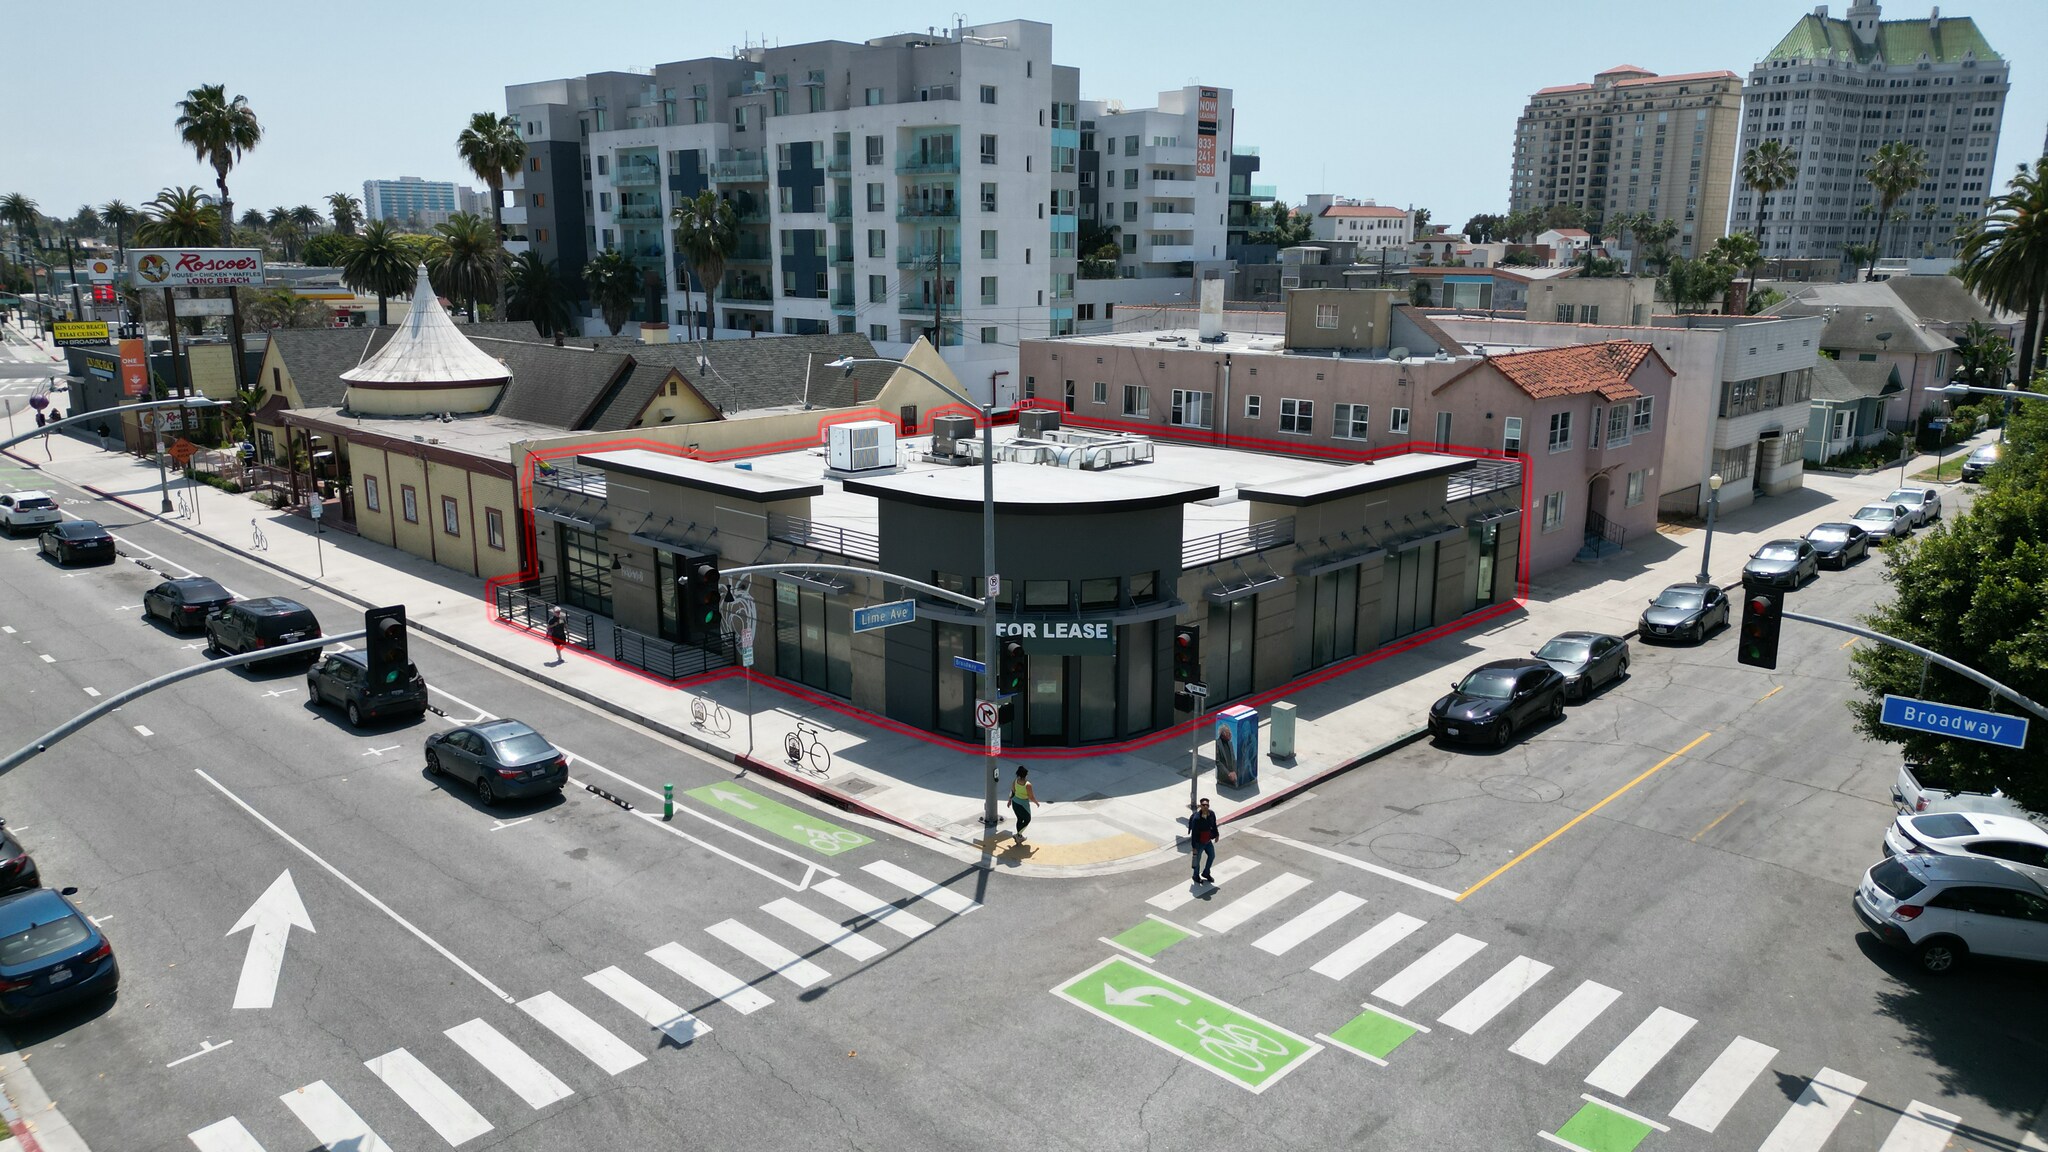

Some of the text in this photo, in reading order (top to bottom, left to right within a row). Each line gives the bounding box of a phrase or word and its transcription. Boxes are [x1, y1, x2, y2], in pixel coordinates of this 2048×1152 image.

[1200, 101, 1217, 111] NOW
[1198, 138, 1215, 149] 833-
[1197, 163, 1214, 173] 3581
[175, 253, 257, 272] Roscoe's
[861, 608, 908, 626] Lime Ave
[995, 622, 1108, 638] FOR LEASE
[1903, 706, 2002, 740] Broadway
